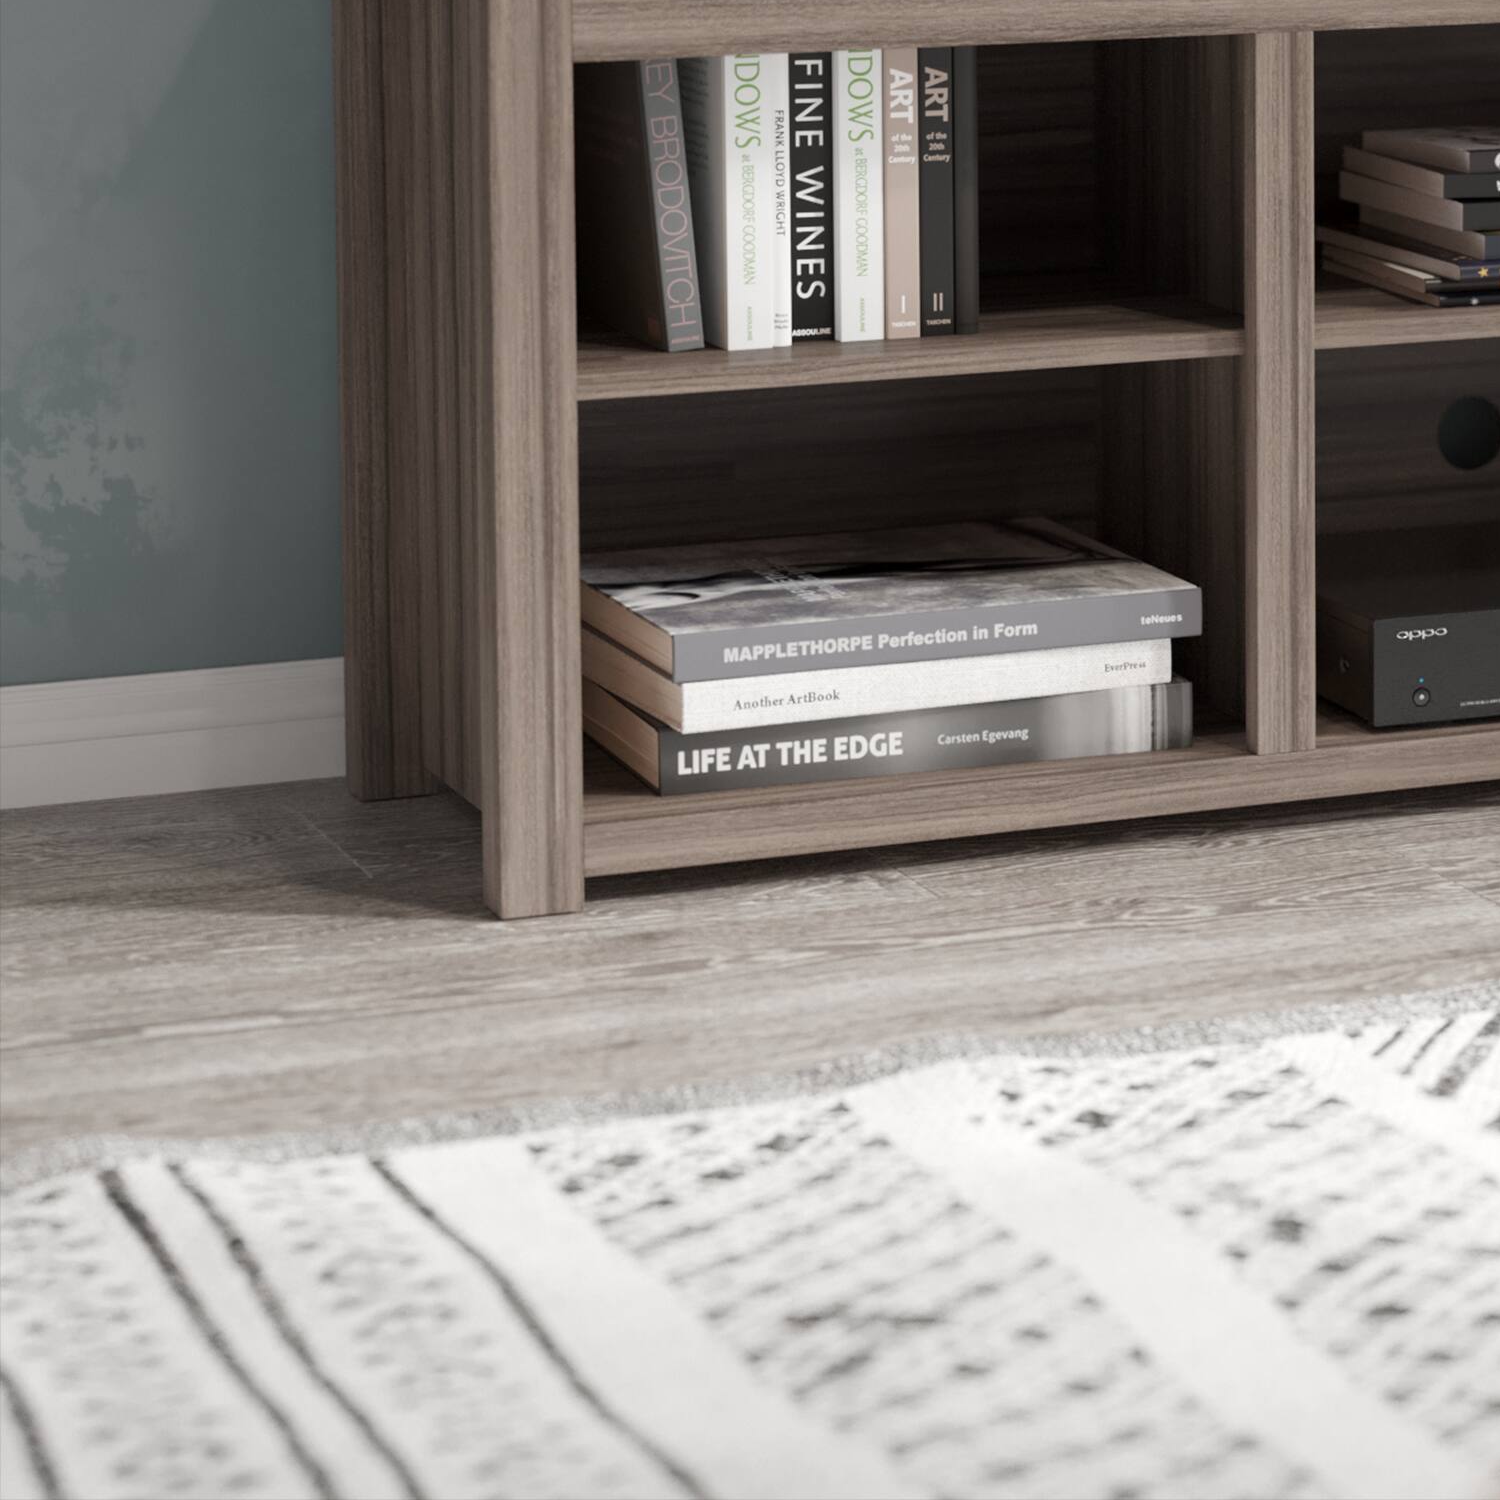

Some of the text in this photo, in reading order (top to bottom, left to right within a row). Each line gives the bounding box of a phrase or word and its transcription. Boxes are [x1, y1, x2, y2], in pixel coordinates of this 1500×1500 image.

[645, 56, 675, 103] EY
[847, 49, 874, 142] DOWS
[889, 67, 914, 123] ART
[924, 66, 949, 122] ART
[891, 132, 913, 142] of the
[922, 154, 951, 164] Century
[926, 131, 948, 141] of the
[774, 109, 786, 236] FRANK LLOYD WRIGHT
[794, 59, 826, 300] FINE WINES
[888, 155, 915, 165] Century
[742, 164, 755, 223] BERGDORF
[855, 158, 869, 216] BERGDORF
[650, 115, 698, 330] BRODOVITCH
[743, 224, 756, 285] GOODMAN
[855, 218, 868, 277] GOODMAN
[723, 620, 1038, 664] MAPPLETHORPE Perfection in Form
[1140, 612, 1183, 626] teNeues
[1396, 627, 1449, 641] oppo
[733, 688, 840, 712] Another ArtBook
[677, 732, 904, 776] LIFE AT THE EDGE
[937, 727, 1029, 746] Carsten Egevang
